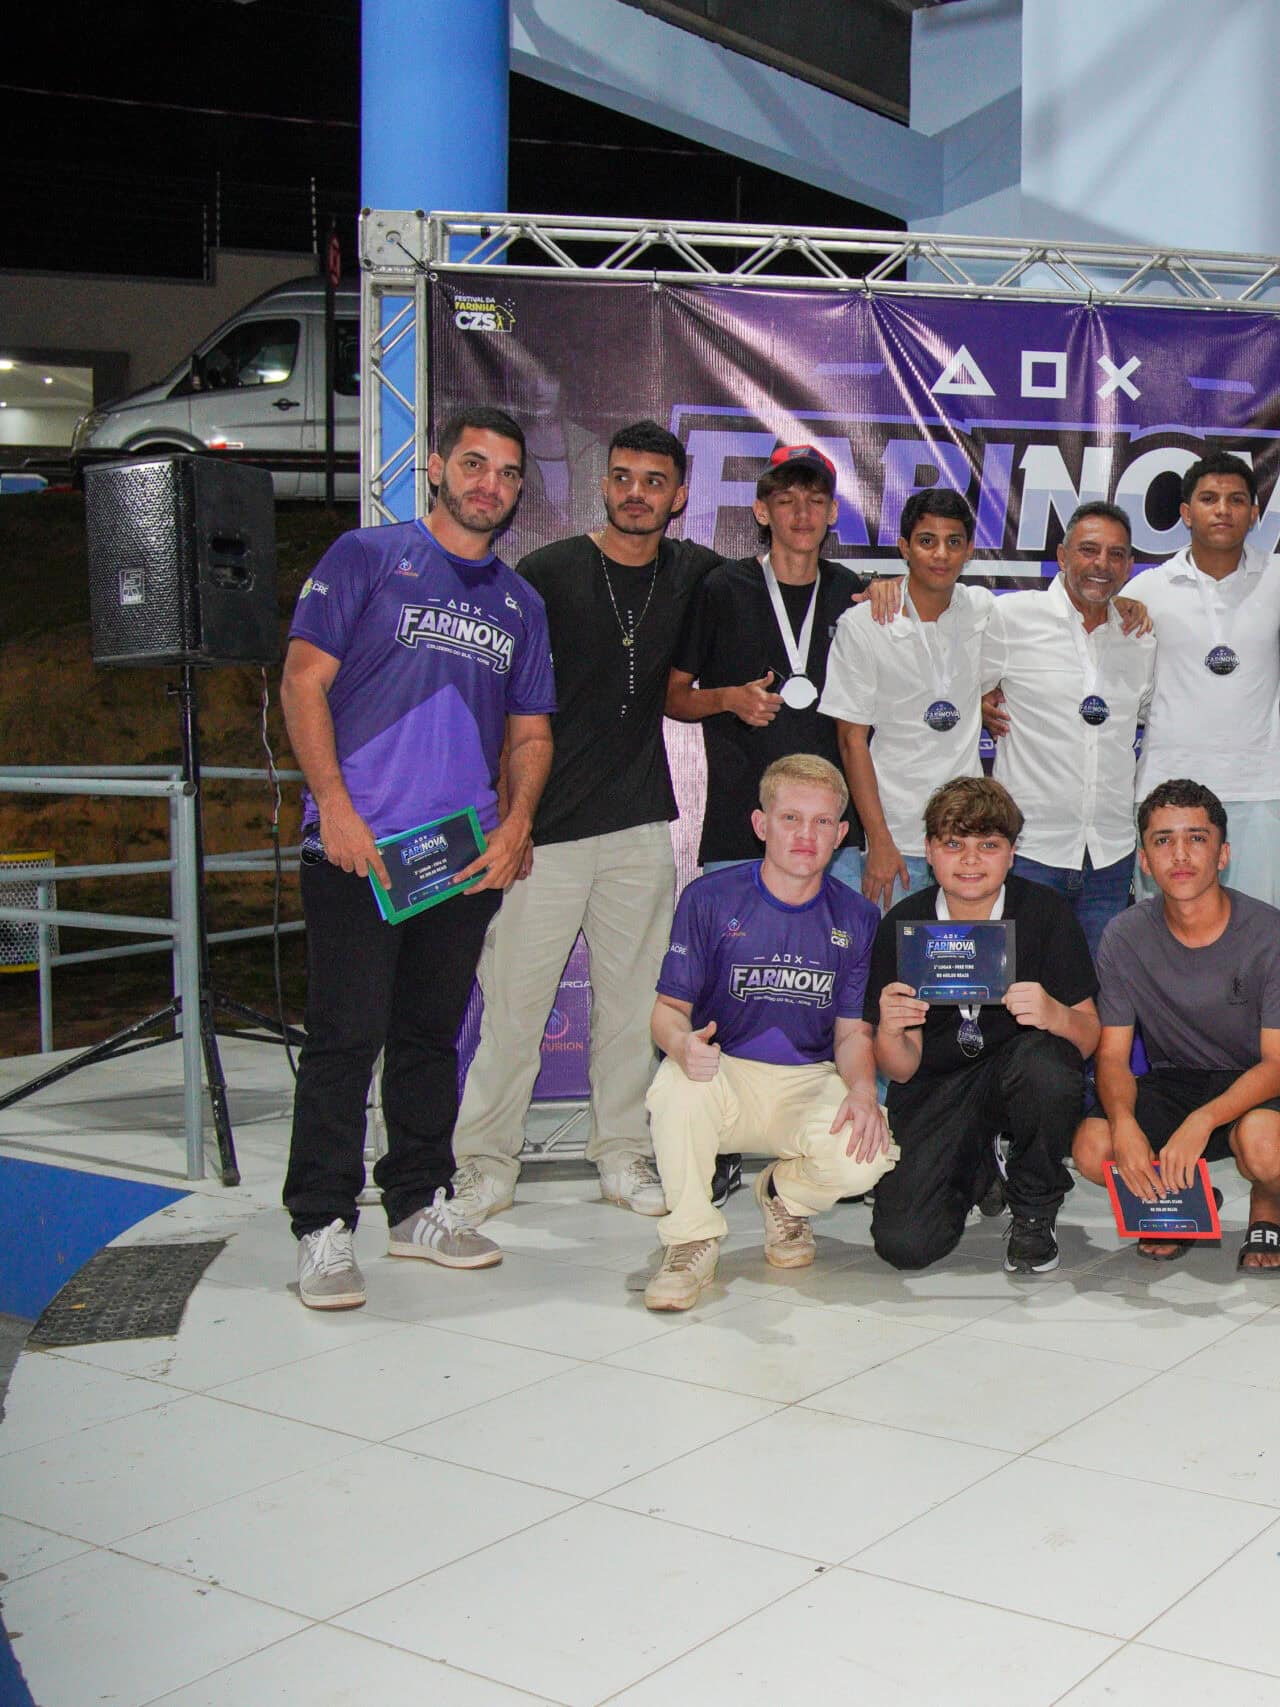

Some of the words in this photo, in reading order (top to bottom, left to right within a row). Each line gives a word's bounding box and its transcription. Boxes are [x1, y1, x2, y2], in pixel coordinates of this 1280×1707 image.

[455, 302, 496, 311] FARINHA
[456, 311, 497, 330] CZS
[401, 608, 514, 667] FARINOVA
[927, 941, 975, 956] FARINOVA
[732, 967, 834, 1000] FARINOVA
